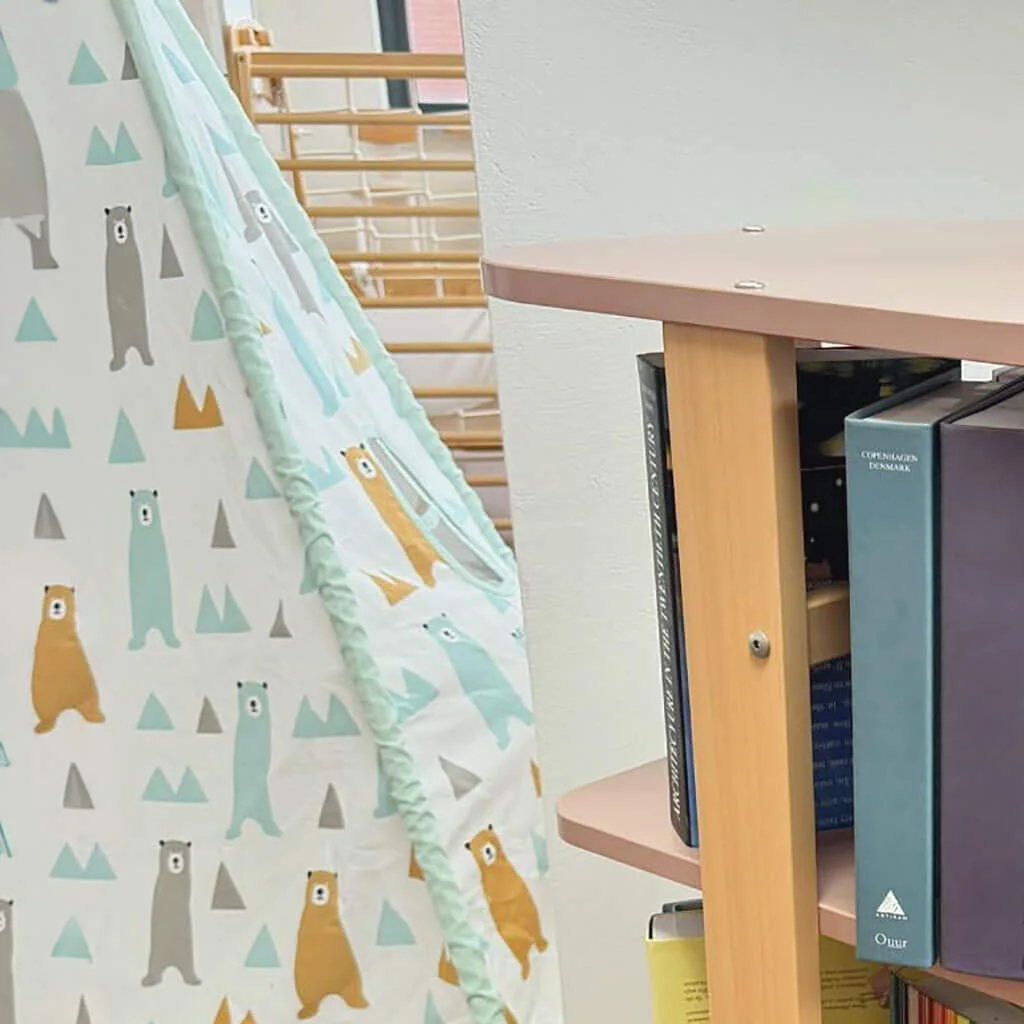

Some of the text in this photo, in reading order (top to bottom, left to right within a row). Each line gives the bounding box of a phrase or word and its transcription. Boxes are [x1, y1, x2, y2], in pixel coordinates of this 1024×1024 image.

[860, 450, 919, 463] COPENHAGEN
[646, 422, 661, 511] CENTURY
[868, 462, 911, 472] DENMARK
